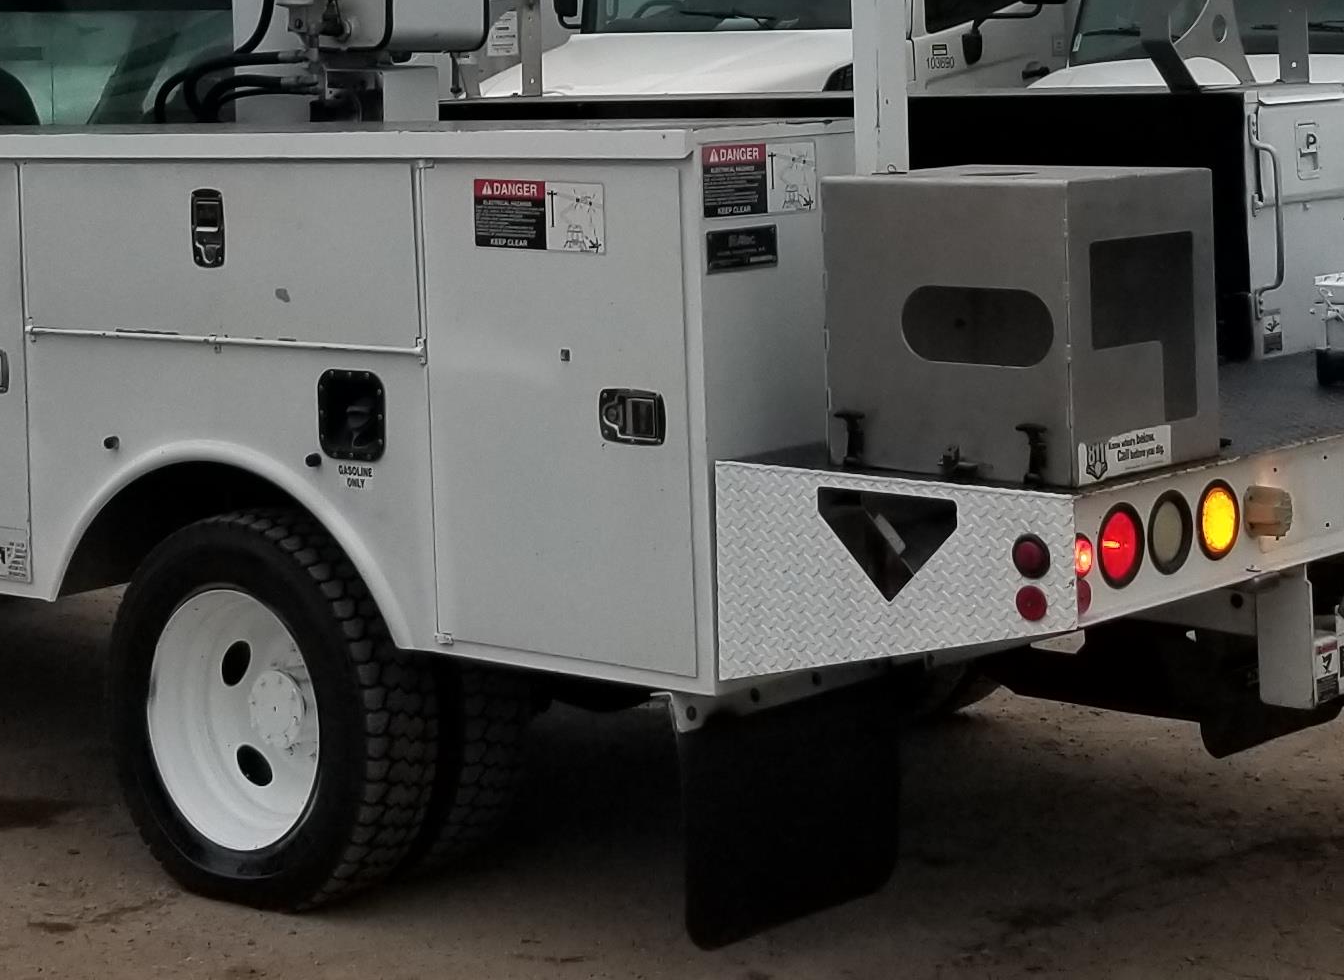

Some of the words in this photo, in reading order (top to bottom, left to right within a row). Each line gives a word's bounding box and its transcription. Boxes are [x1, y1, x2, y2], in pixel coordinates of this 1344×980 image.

[720, 147, 759, 161] DANGER
[493, 182, 537, 197] DANGER
[717, 206, 733, 215] KEEP
[733, 205, 752, 214] CLEAR
[490, 238, 506, 246] KEEP
[507, 239, 528, 247] CLEAR
[338, 464, 373, 478] GASOLINE
[347, 477, 366, 489] ONLY
